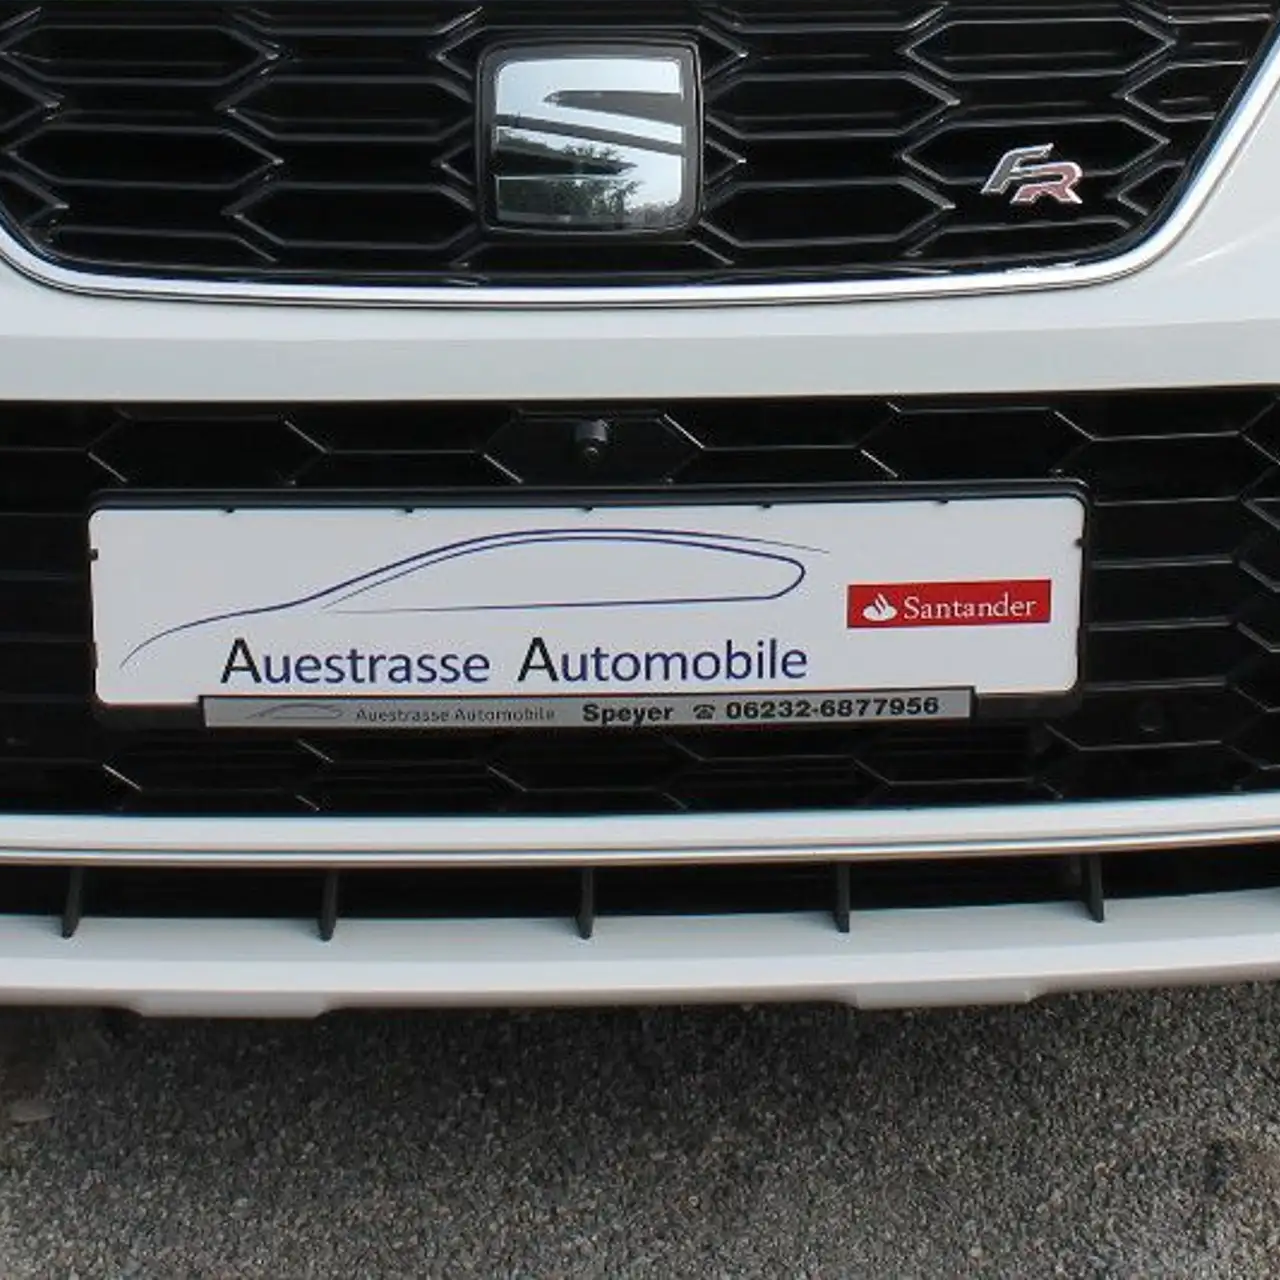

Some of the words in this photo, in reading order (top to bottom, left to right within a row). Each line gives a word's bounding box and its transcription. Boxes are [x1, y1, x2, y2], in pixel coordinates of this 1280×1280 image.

[904, 592, 1037, 621] Santander
[220, 637, 491, 685] Auestrasse
[518, 635, 809, 683] Automobile
[355, 707, 450, 722] Auestrasse
[454, 706, 555, 721] Automobile
[582, 702, 674, 725] Speyer
[726, 696, 940, 721] 06232-6877956
